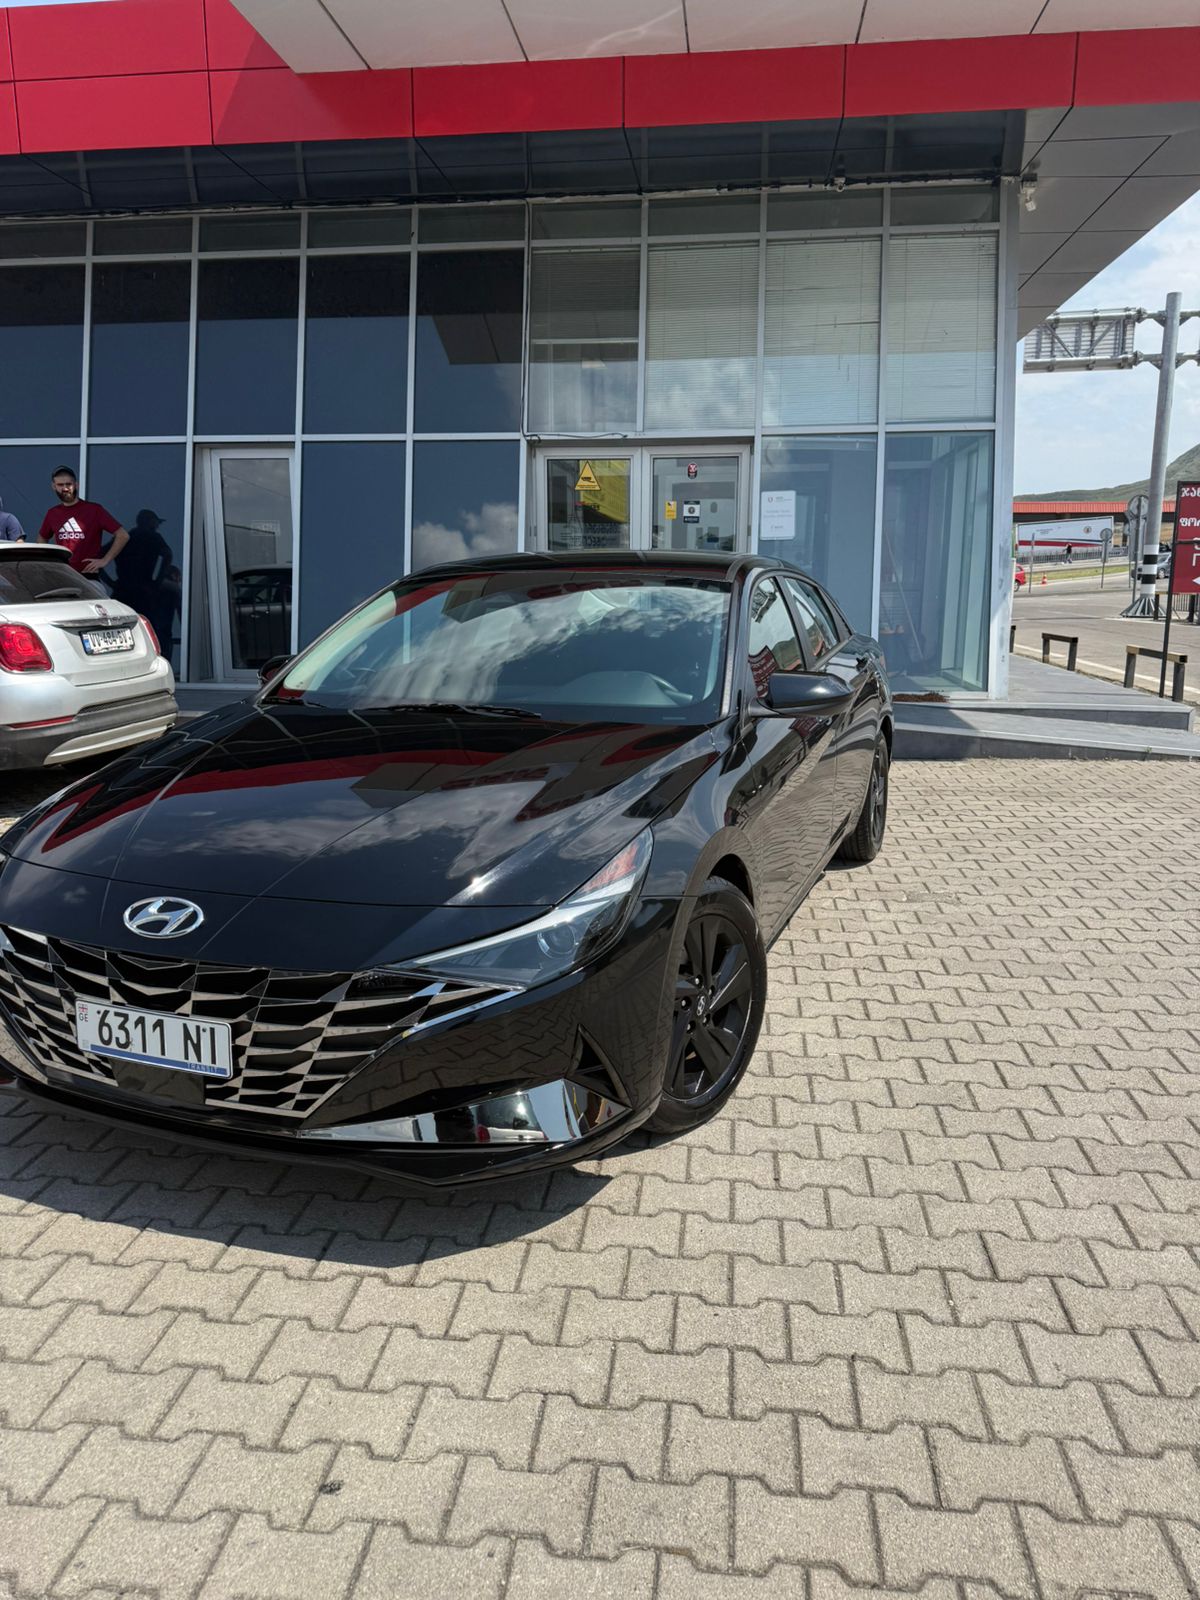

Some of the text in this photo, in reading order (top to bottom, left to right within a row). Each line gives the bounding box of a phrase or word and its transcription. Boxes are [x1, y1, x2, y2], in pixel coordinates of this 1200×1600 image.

[59, 532, 85, 540] adidas
[78, 1012, 89, 1023] GE
[97, 1009, 217, 1065] 6311 NI
[186, 1062, 218, 1074] TRANSIT
